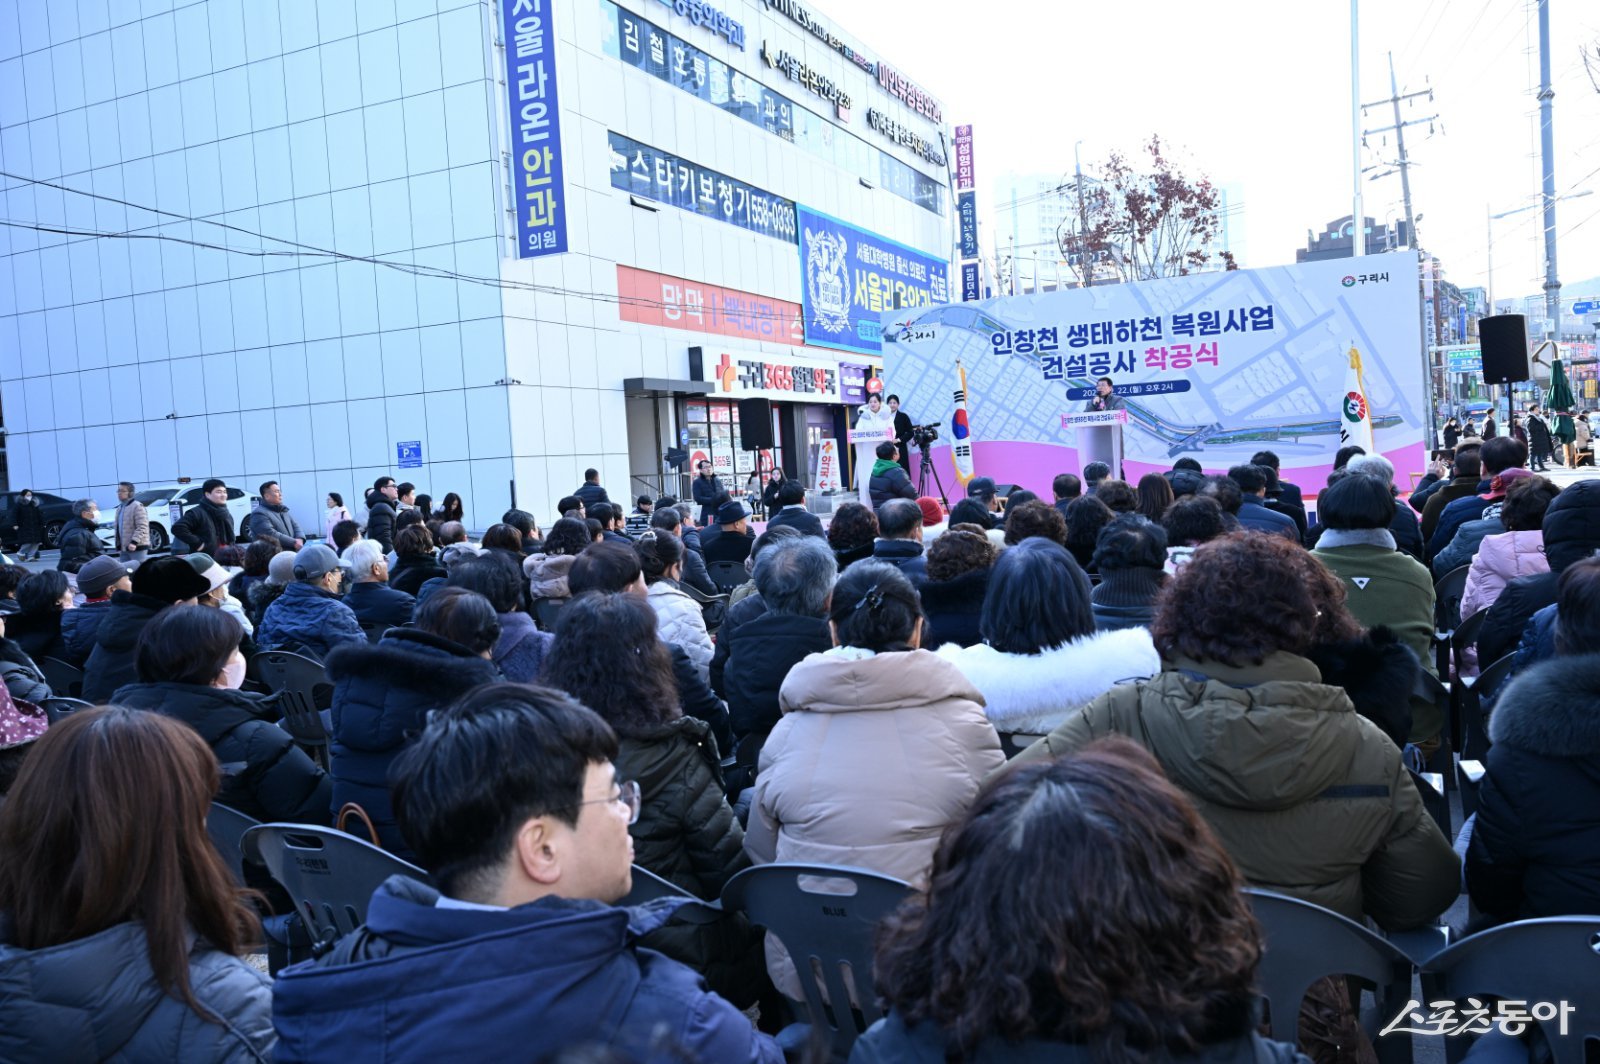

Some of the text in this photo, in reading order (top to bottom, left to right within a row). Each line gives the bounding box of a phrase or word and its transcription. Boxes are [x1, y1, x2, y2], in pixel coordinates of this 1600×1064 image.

[958, 144, 973, 189] 성형외과
[631, 149, 796, 237] 스타키보청기 558-0333
[528, 231, 557, 250] 의원
[909, 261, 927, 283] 의료진
[1358, 272, 1389, 285] 구리시
[662, 283, 704, 325] 망막
[723, 295, 776, 336] 백내장
[991, 305, 1274, 356] 인창천 생태하천 복원사업
[738, 360, 836, 395] 구리365열린약국
[1042, 342, 1219, 380] 건설공사 착공식
[1146, 384, 1160, 394] 오후
[1161, 384, 1174, 393] 2시
[403, 448, 410, 458] P
[822, 906, 848, 918] BLUE
